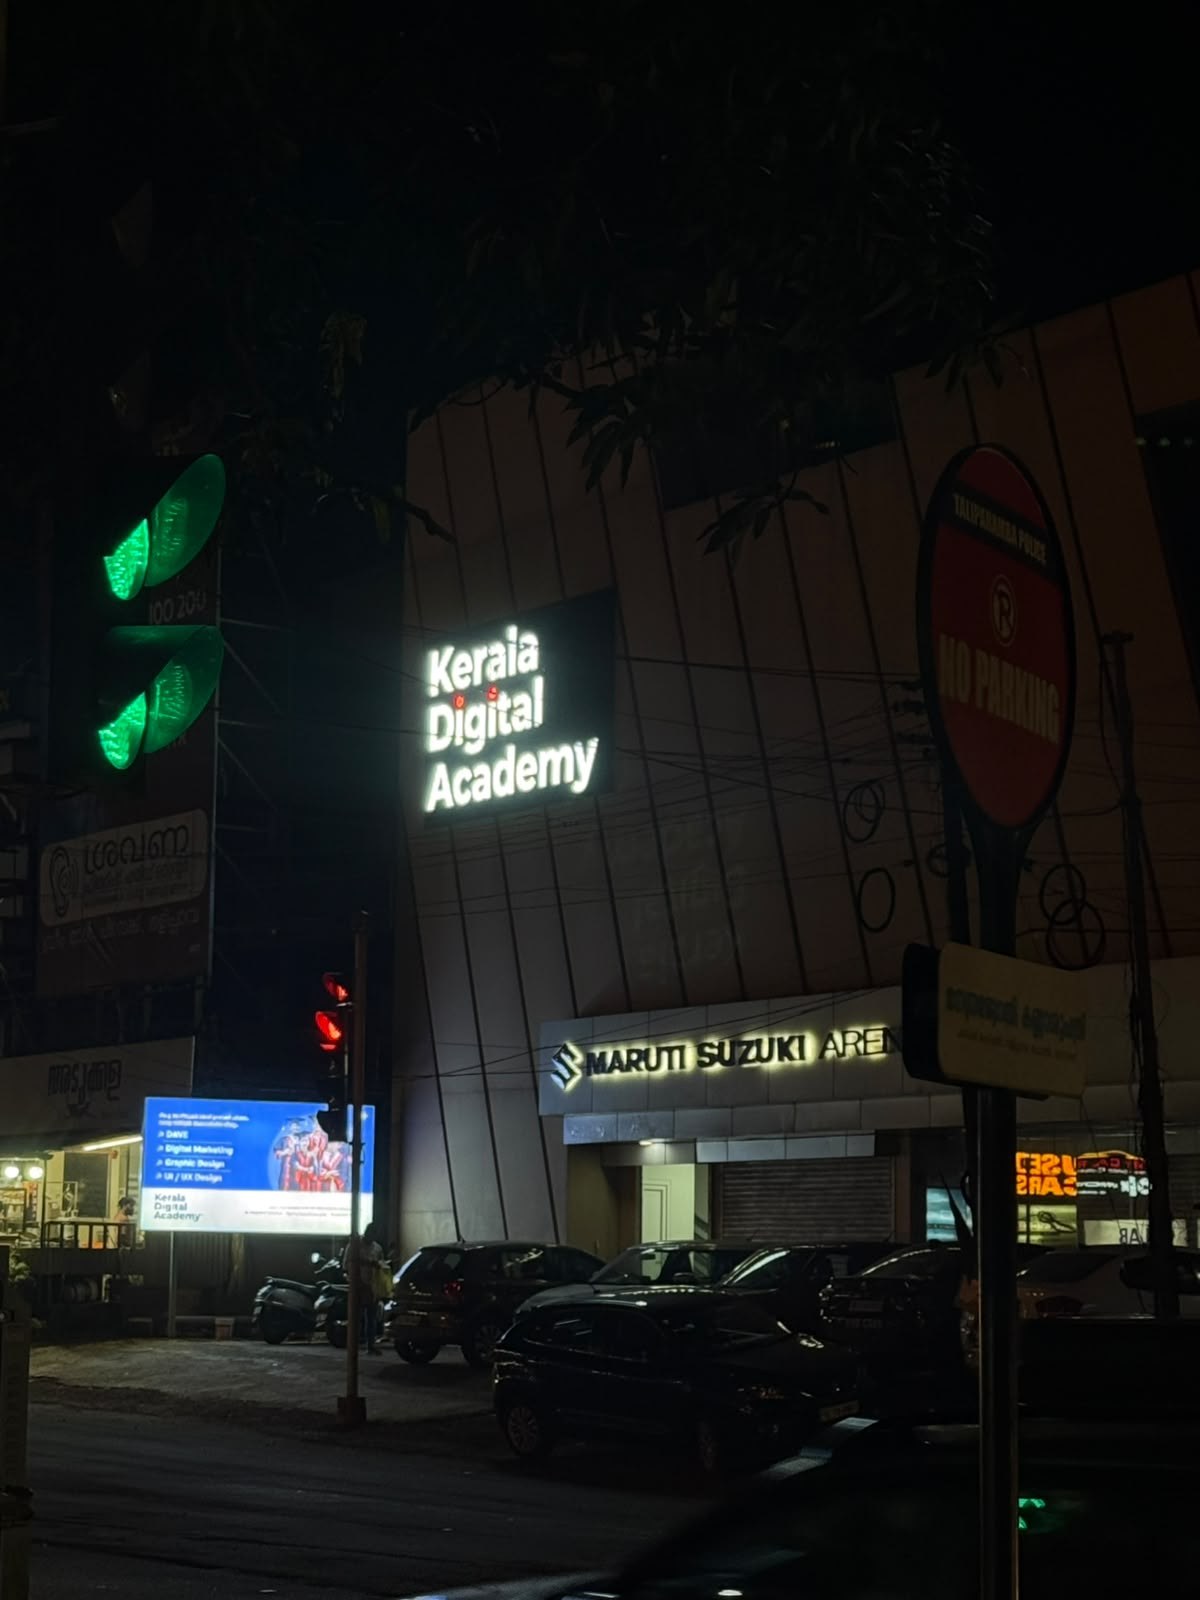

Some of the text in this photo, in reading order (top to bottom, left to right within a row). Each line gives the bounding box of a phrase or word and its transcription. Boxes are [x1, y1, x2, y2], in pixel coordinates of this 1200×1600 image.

[1018, 528, 1048, 567] POLICE
[426, 624, 540, 697] Kerala
[938, 633, 1060, 744] NO PARKING
[425, 675, 545, 755] Digital
[423, 737, 600, 812] Academy
[586, 1044, 686, 1076] MARUTI
[696, 1035, 806, 1068] SUZUKI
[164, 1144, 192, 1155] Digital
[197, 1159, 225, 1170] Design
[154, 1193, 186, 1202] Kerala
[154, 1202, 187, 1212] Digital
[154, 1211, 201, 1222] Academy
